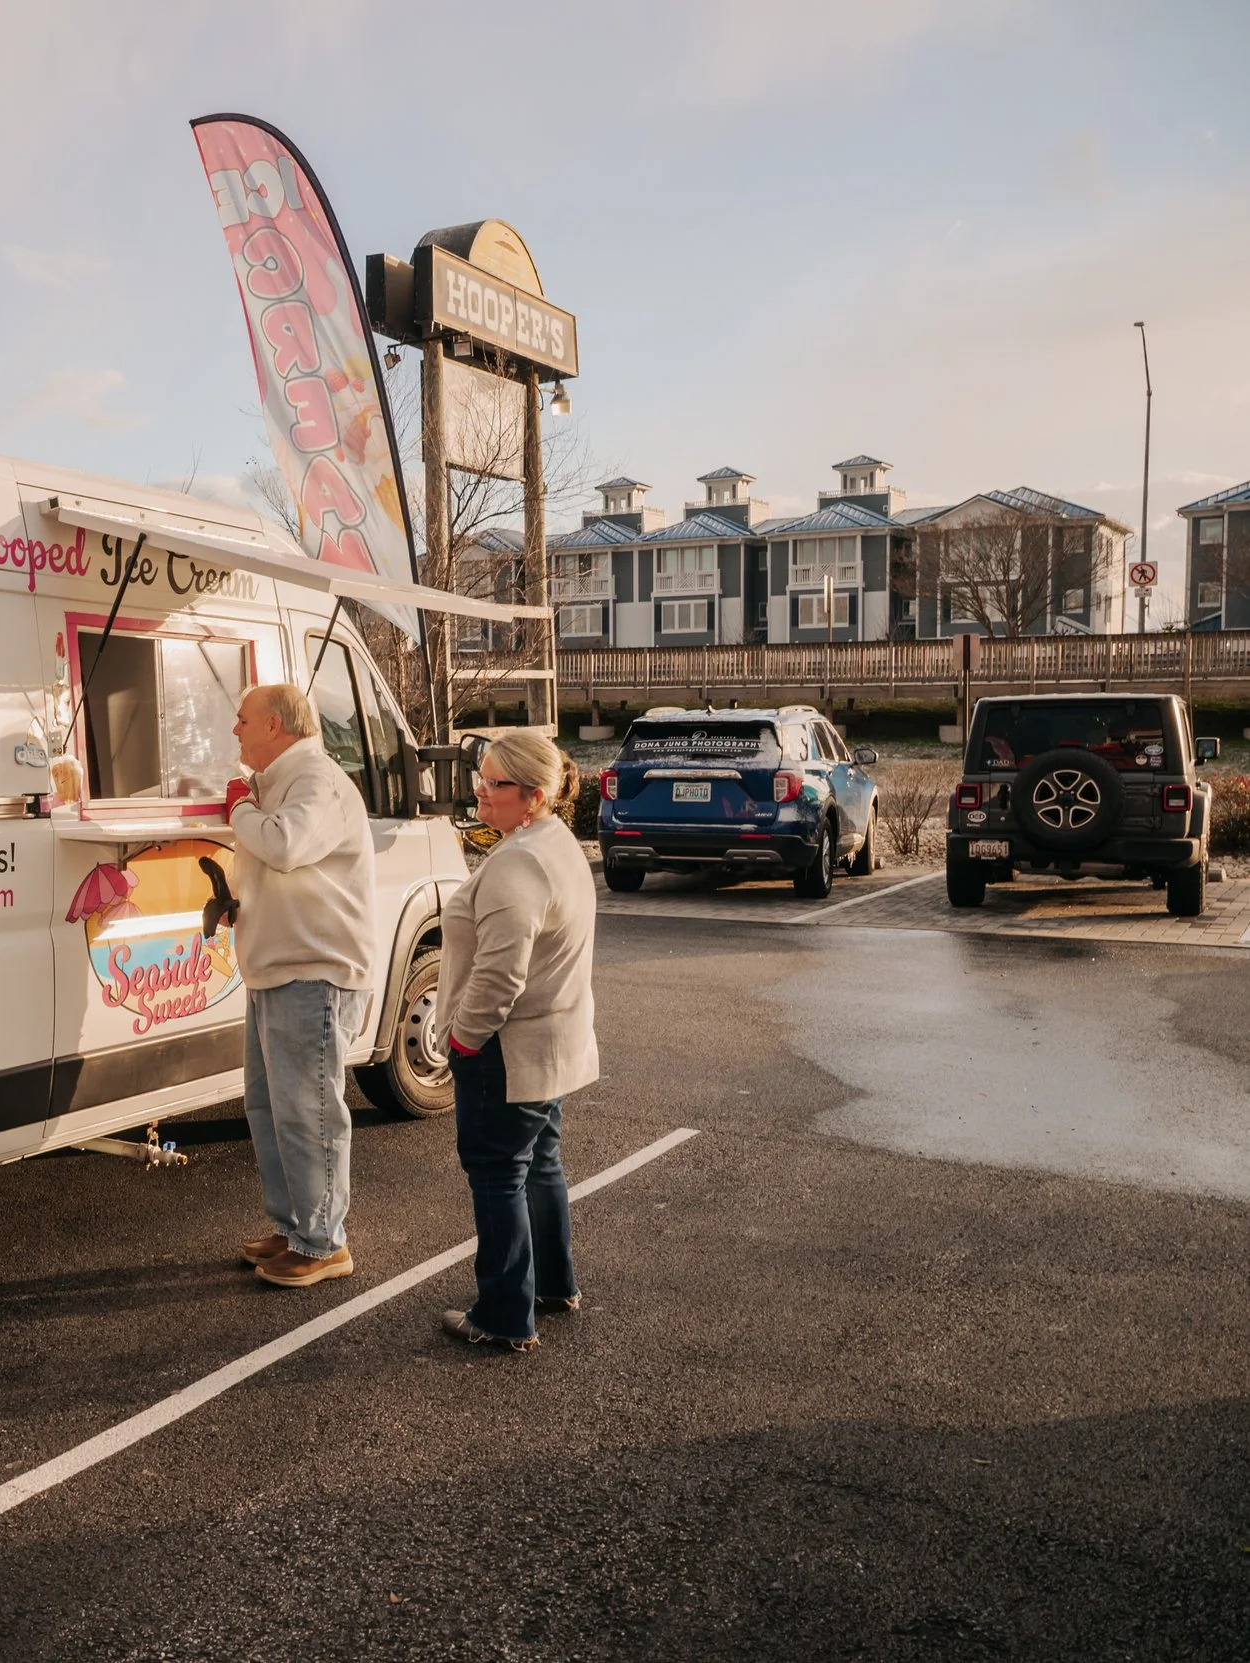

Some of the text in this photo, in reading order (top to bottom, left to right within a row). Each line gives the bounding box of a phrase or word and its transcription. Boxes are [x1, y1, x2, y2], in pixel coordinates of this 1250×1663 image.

[447, 268, 565, 360] HOOPER'S
[100, 533, 158, 586] Ice
[165, 550, 259, 600] Cream
[692, 740, 763, 748] PHOTOGRAPHY
[102, 932, 213, 1008] Seaside
[132, 982, 207, 1035] Sweets
